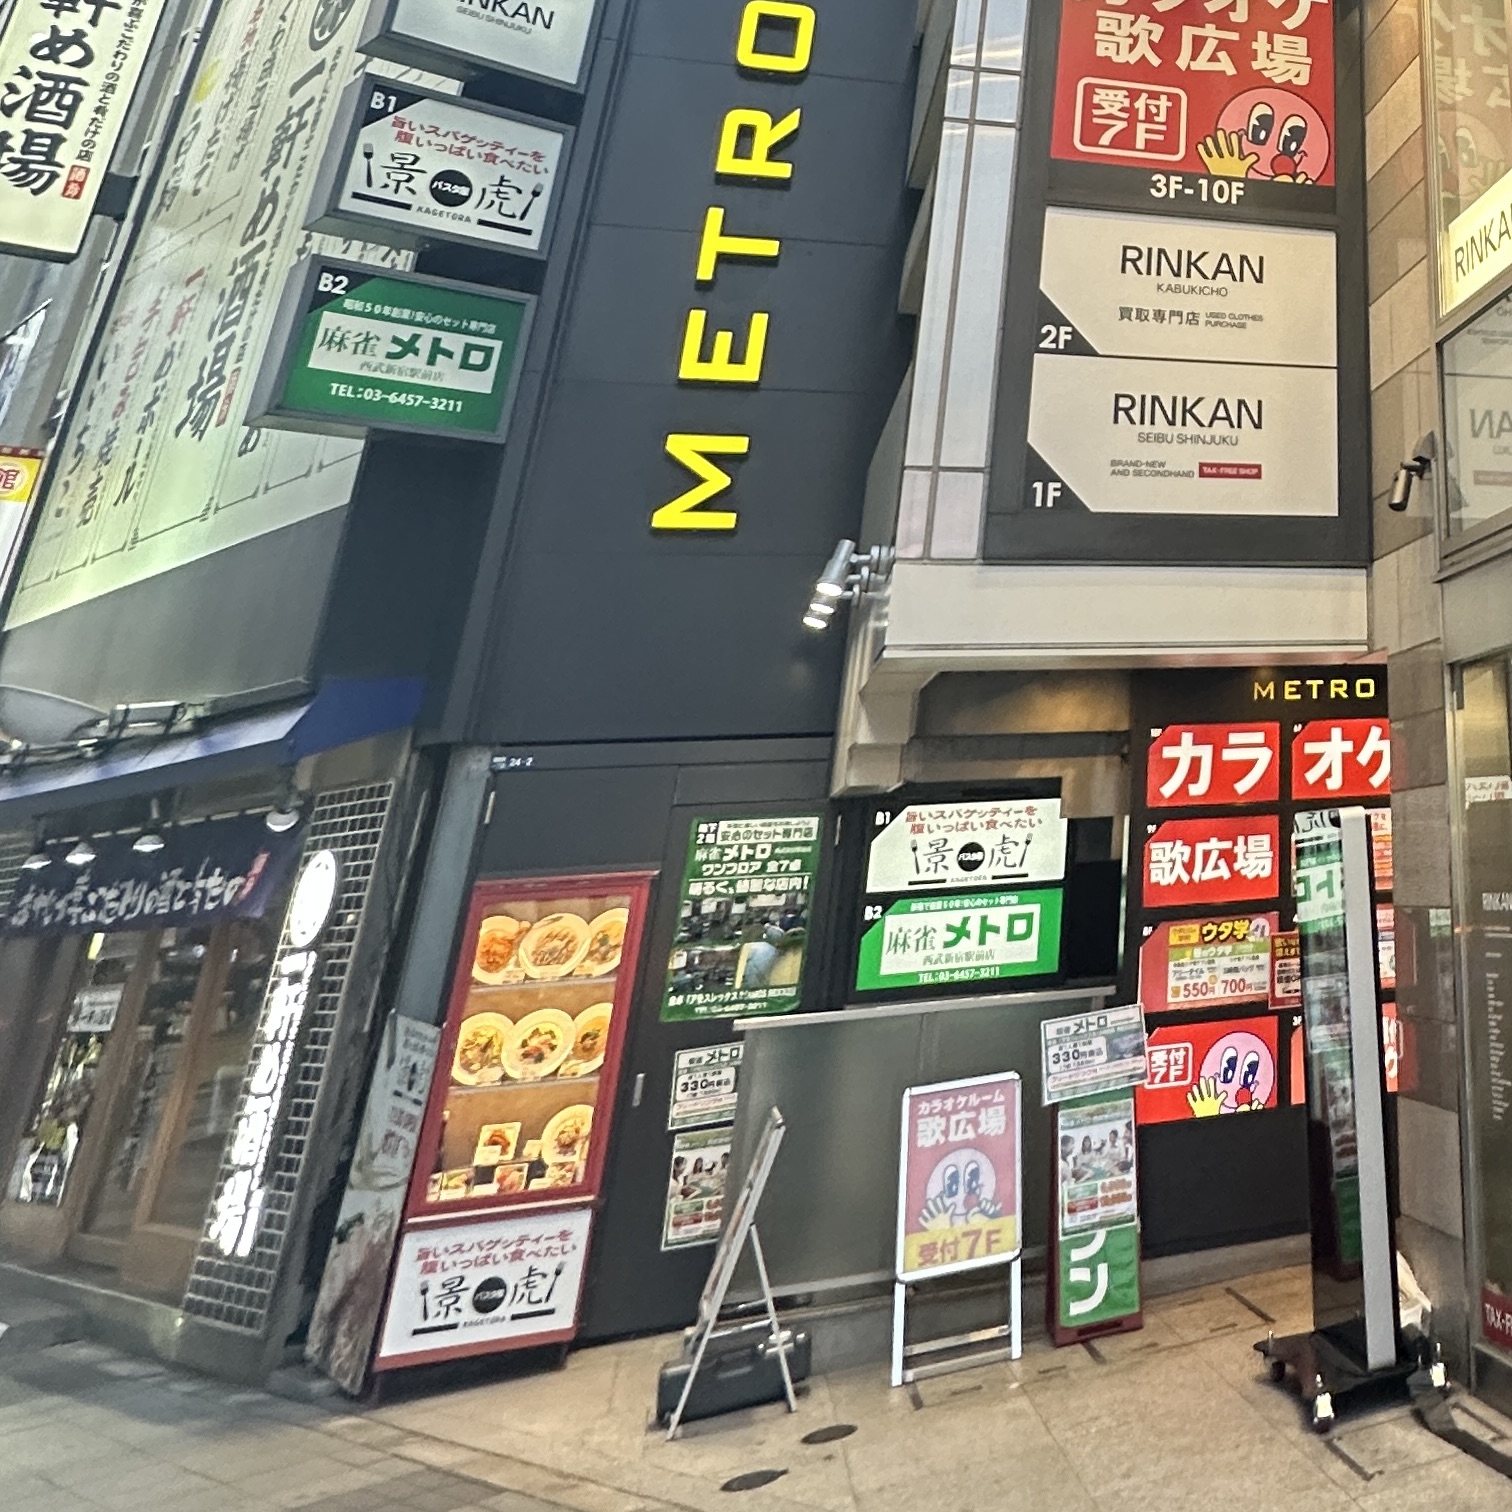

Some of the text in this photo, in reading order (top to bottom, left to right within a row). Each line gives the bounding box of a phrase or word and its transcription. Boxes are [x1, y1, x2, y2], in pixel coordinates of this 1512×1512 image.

[1094, 10, 1313, 86] 歌広場
[370, 91, 397, 113] B1
[1092, 88, 1173, 123] 受付
[1092, 118, 1168, 150] 7F
[1150, 173, 1245, 205] 3F-10F
[415, 205, 473, 224] KAGETORA
[652, 0, 815, 530] METRO
[1120, 244, 1265, 285] RINKAN
[317, 272, 350, 295] B2
[1156, 283, 1229, 297] KABUKICHO
[1118, 306, 1201, 326] 買取専門店
[1039, 324, 1073, 349] 2F
[1112, 393, 1264, 430] RINKAN
[1137, 432, 1239, 446] SEIBU SHINJUKU
[1110, 459, 1167, 469] BRAND-NEW
[1110, 469, 1131, 477] AND
[1032, 481, 1062, 508] 1F
[1253, 678, 1376, 701] METRO
[875, 811, 890, 826] B1
[702, 861, 762, 876] ワンフロア
[1149, 834, 1274, 886] 歌広場
[864, 906, 883, 920] B2
[918, 1089, 1005, 1115] カラオケルーム
[916, 1105, 1006, 1148] 歌広場
